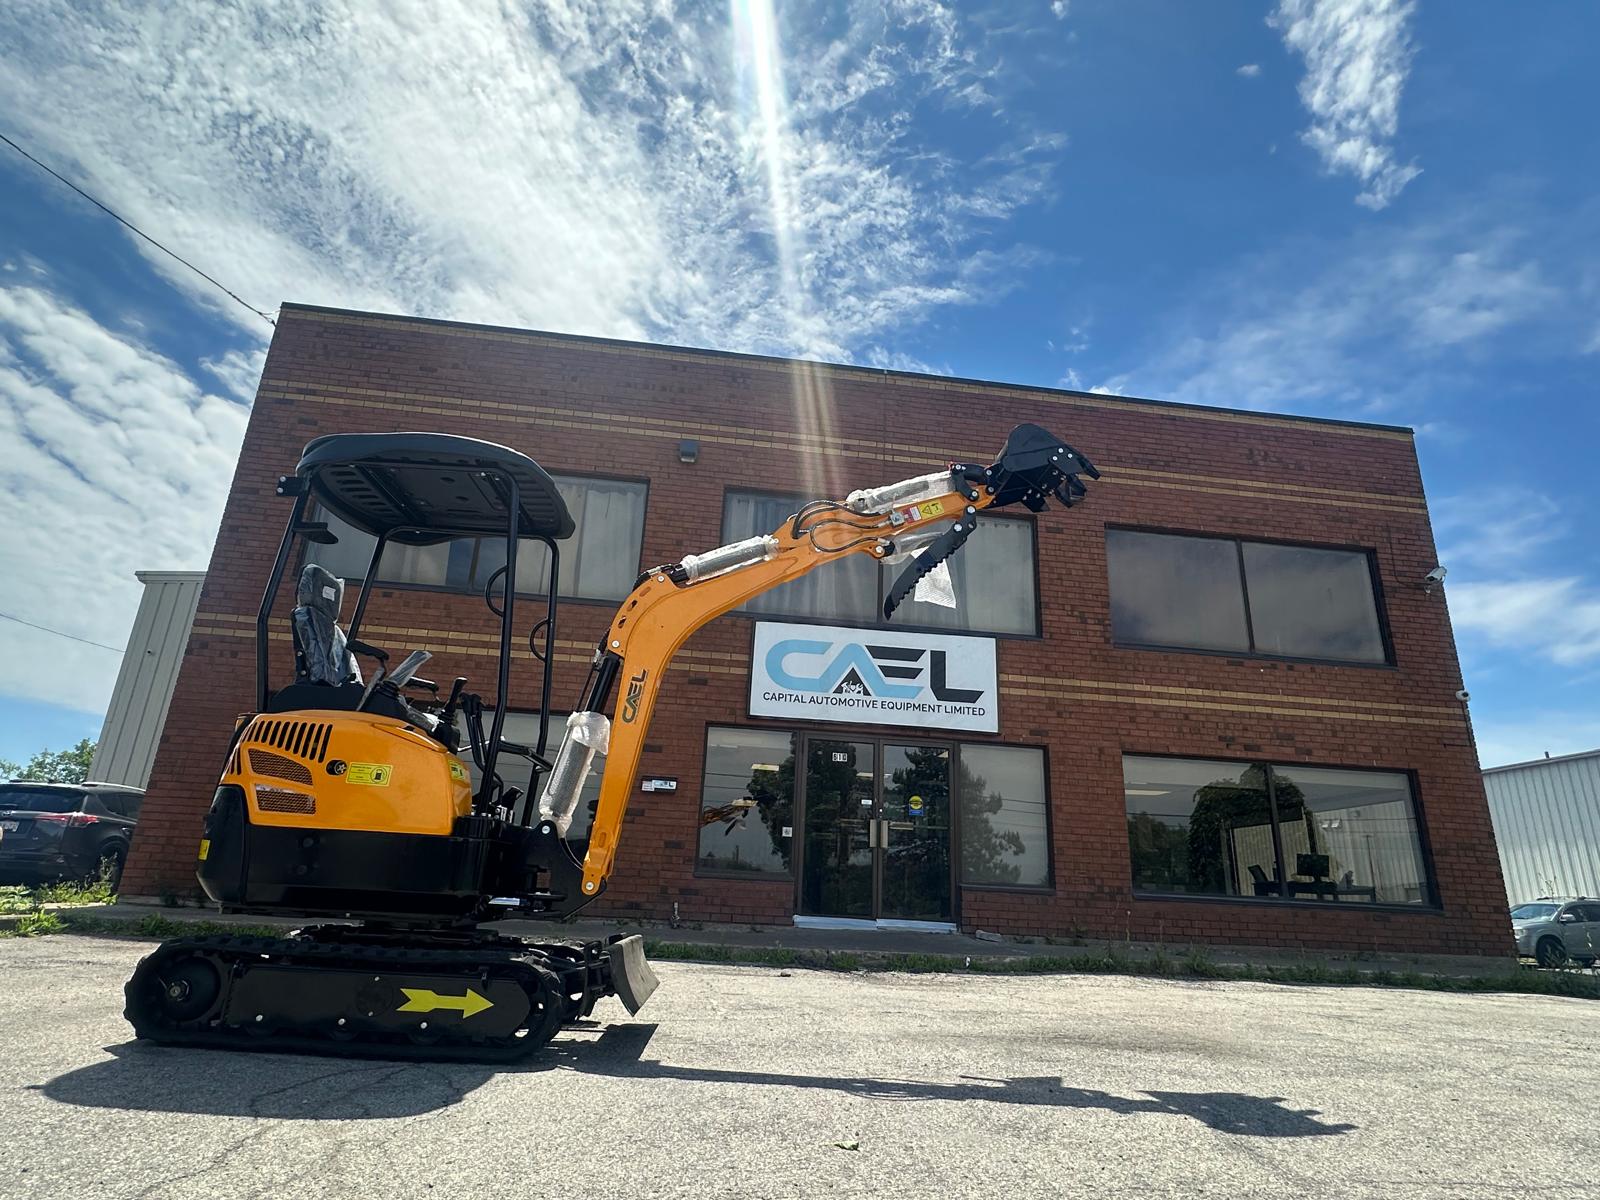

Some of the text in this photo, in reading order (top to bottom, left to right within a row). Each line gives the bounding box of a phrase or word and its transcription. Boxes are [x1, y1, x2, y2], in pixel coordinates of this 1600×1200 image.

[622, 669, 648, 723] CAEL
[765, 639, 985, 703] CAEL
[763, 691, 986, 716] CAPITAL AUTOMOTIVE EQUIPMENT LIMITED
